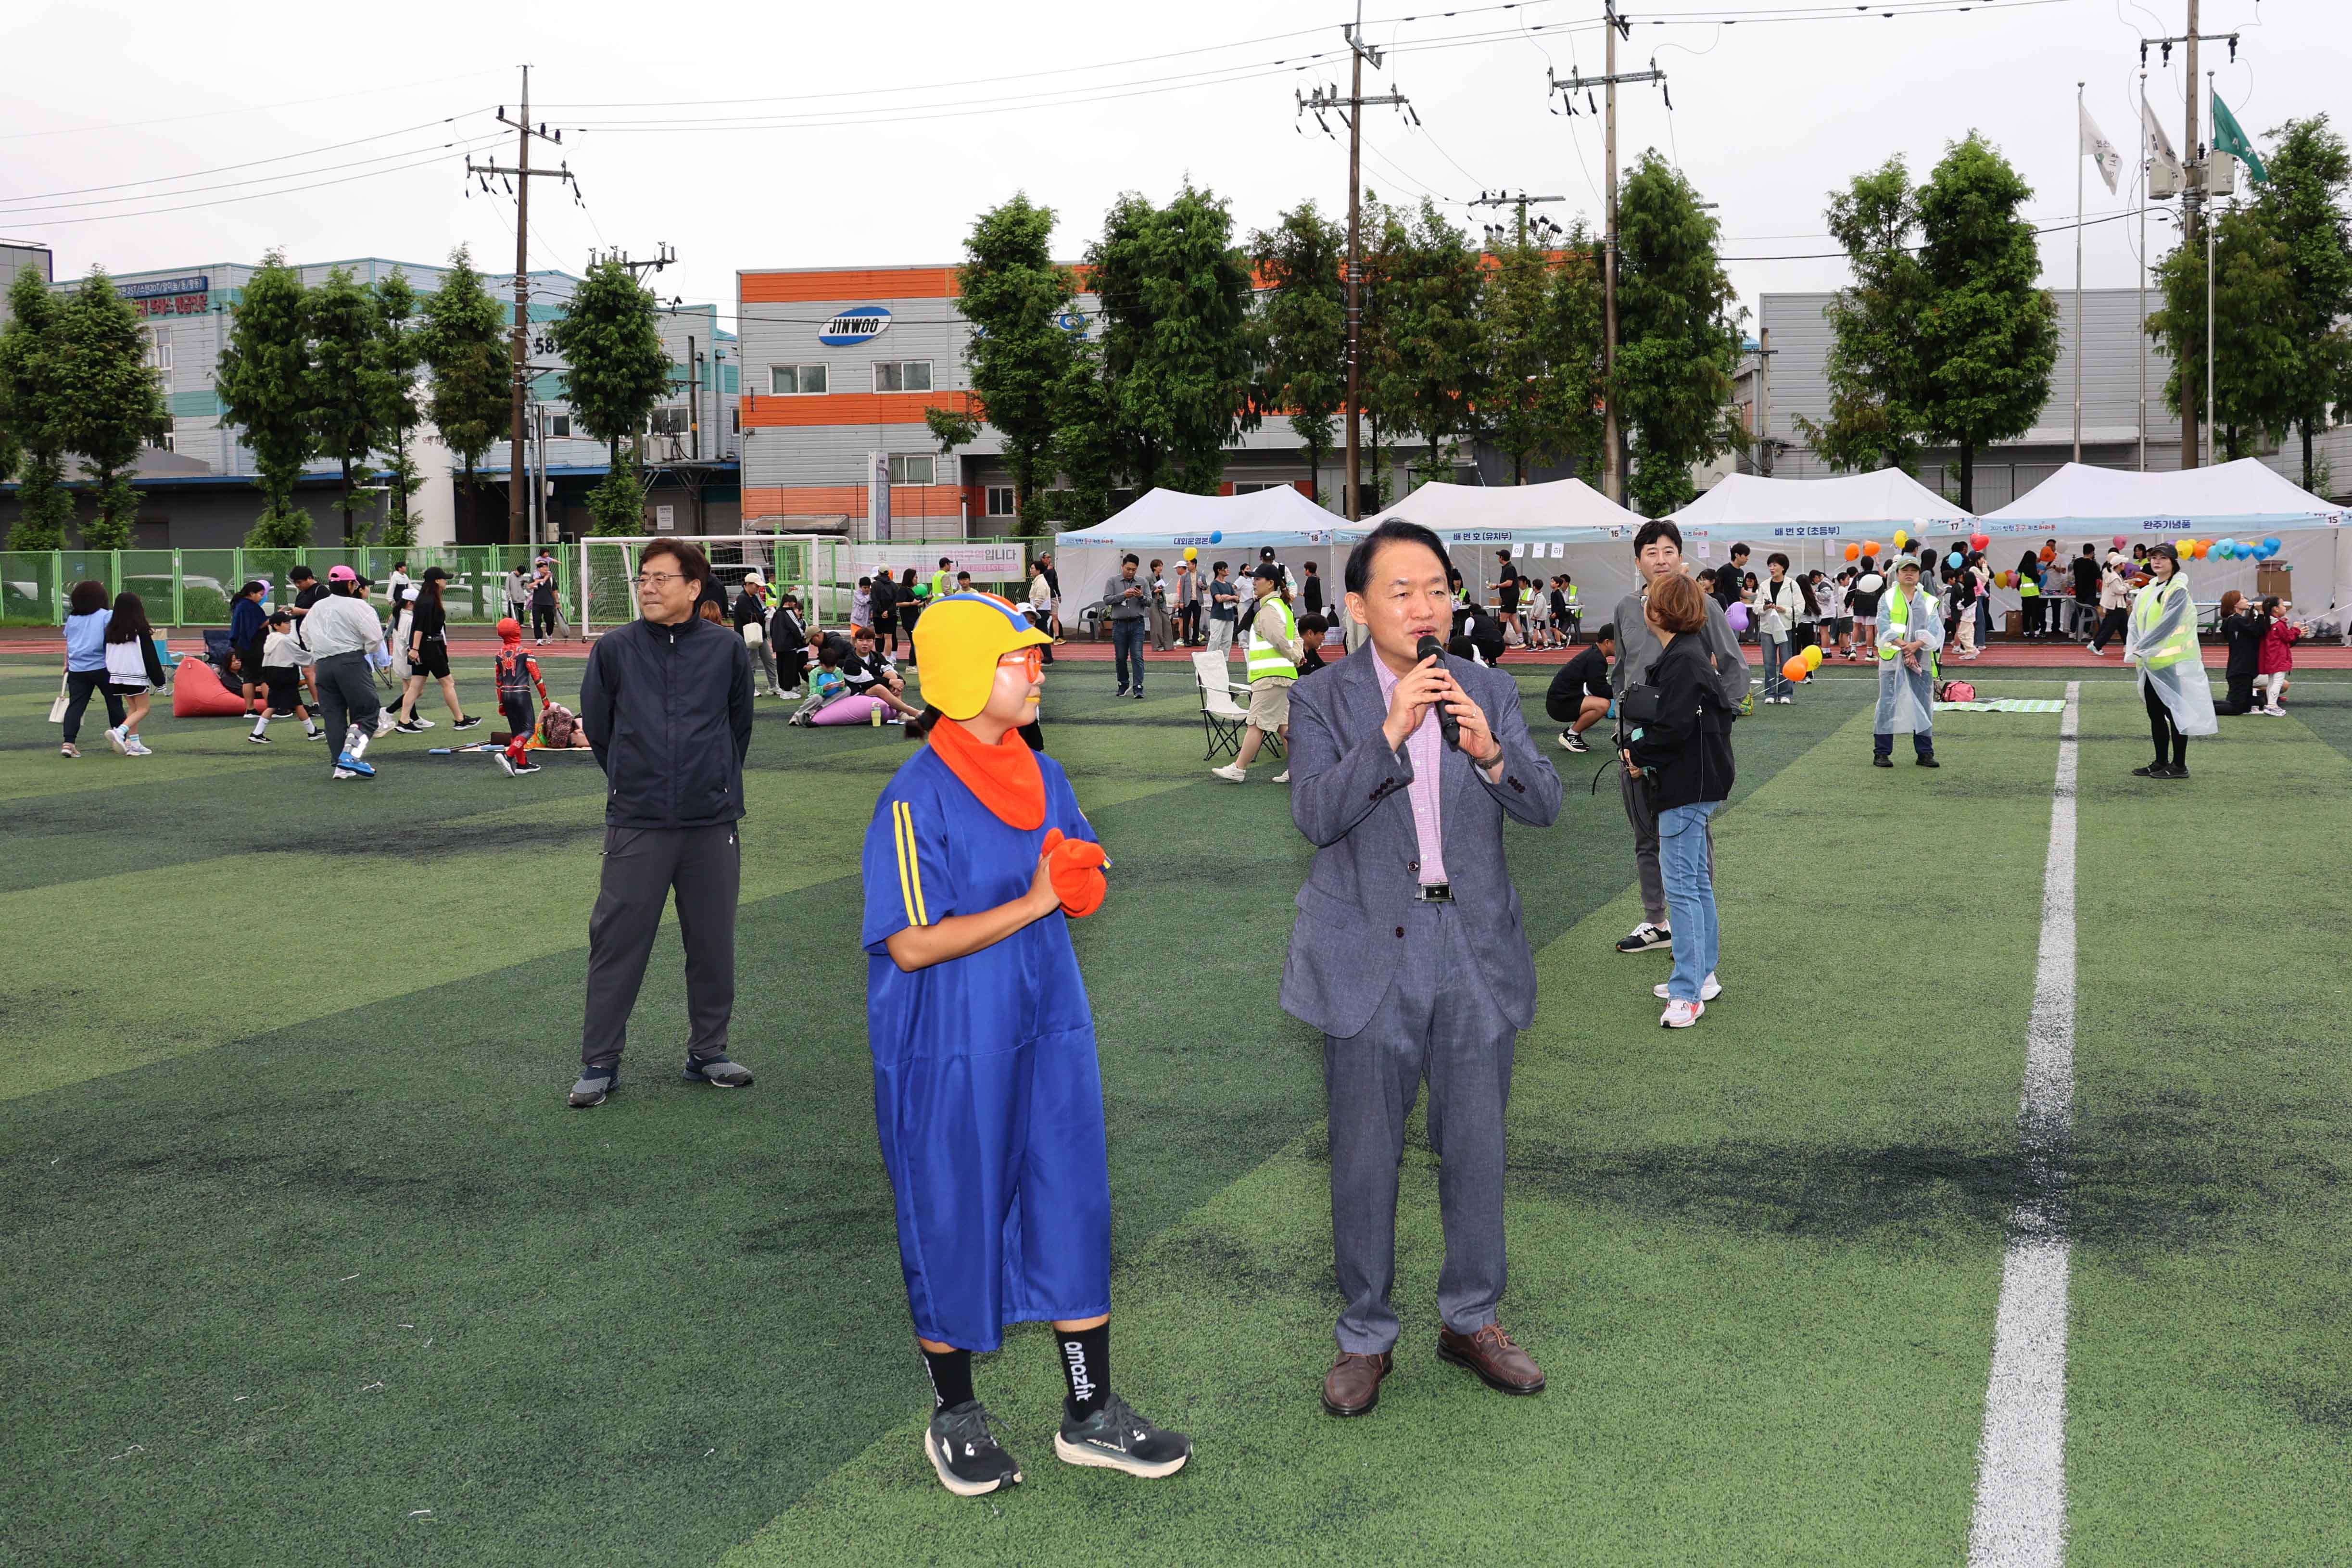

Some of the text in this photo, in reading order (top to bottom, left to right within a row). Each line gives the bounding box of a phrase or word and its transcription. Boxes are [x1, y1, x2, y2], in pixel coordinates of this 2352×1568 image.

[829, 318, 879, 334] JINWOO
[2143, 520, 2191, 529] 완주기념품
[1483, 531, 1512, 541] (유치부)
[1775, 526, 1840, 536] 배 번 호 (초등부)
[1064, 1341, 1096, 1402] amazfit
